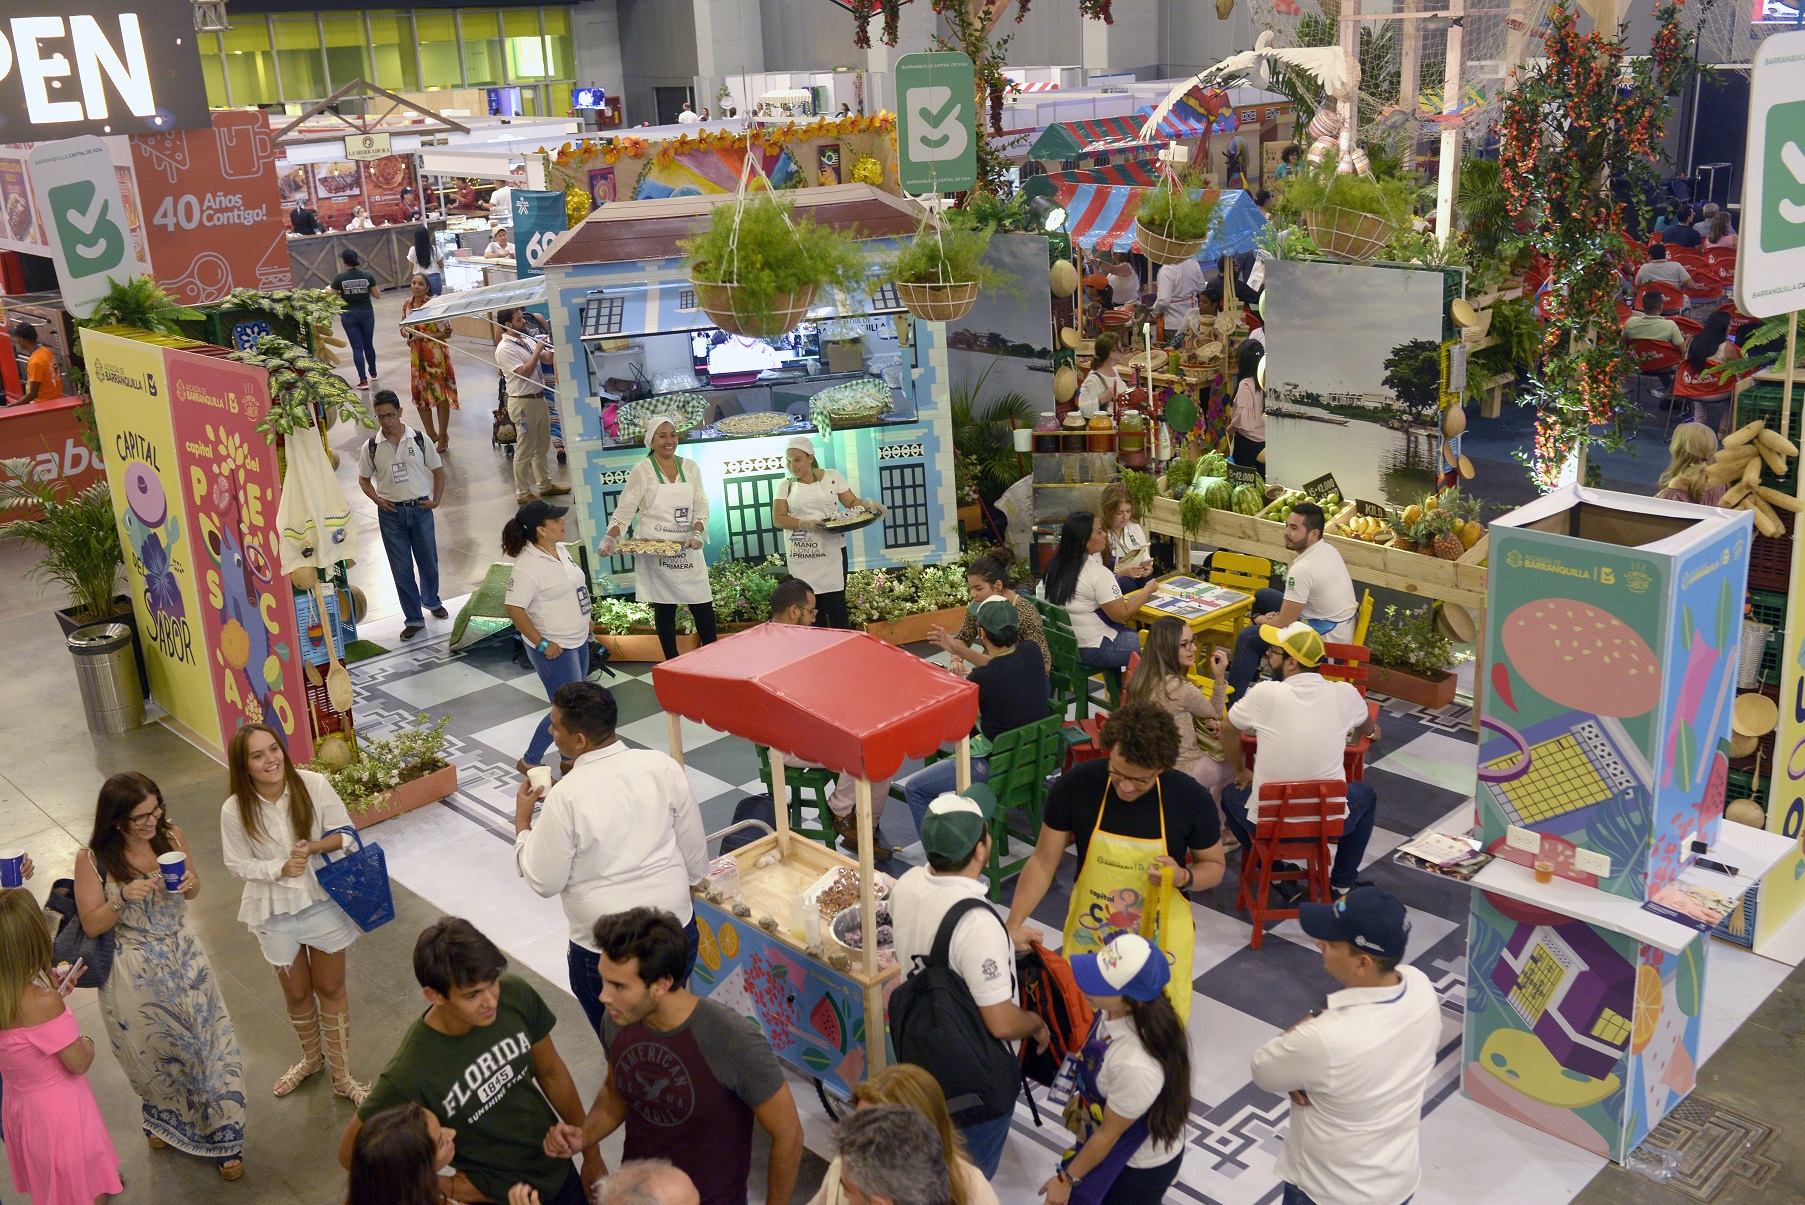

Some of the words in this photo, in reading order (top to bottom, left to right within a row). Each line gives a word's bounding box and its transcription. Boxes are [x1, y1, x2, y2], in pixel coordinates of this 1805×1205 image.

[0, 13, 156, 125] EN
[152, 194, 201, 232] 40
[203, 192, 243, 210] Años
[202, 203, 267, 227] Contigo!
[1752, 284, 1796, 299] BARRANQUILLA
[104, 370, 144, 391] BARRANQUILLA
[186, 390, 225, 409] BARRANQUILLA
[116, 430, 161, 473] CAPITAL
[185, 440, 213, 459] capital
[245, 455, 260, 473] del
[663, 562, 694, 570] PRIMERA
[1524, 560, 1591, 579] BARRANQUILLA
[144, 587, 196, 666] SABOR
[1089, 888, 1115, 903] capital
[441, 1031, 532, 1119] FLORIDA
[620, 1045, 688, 1087] AMERICAN
